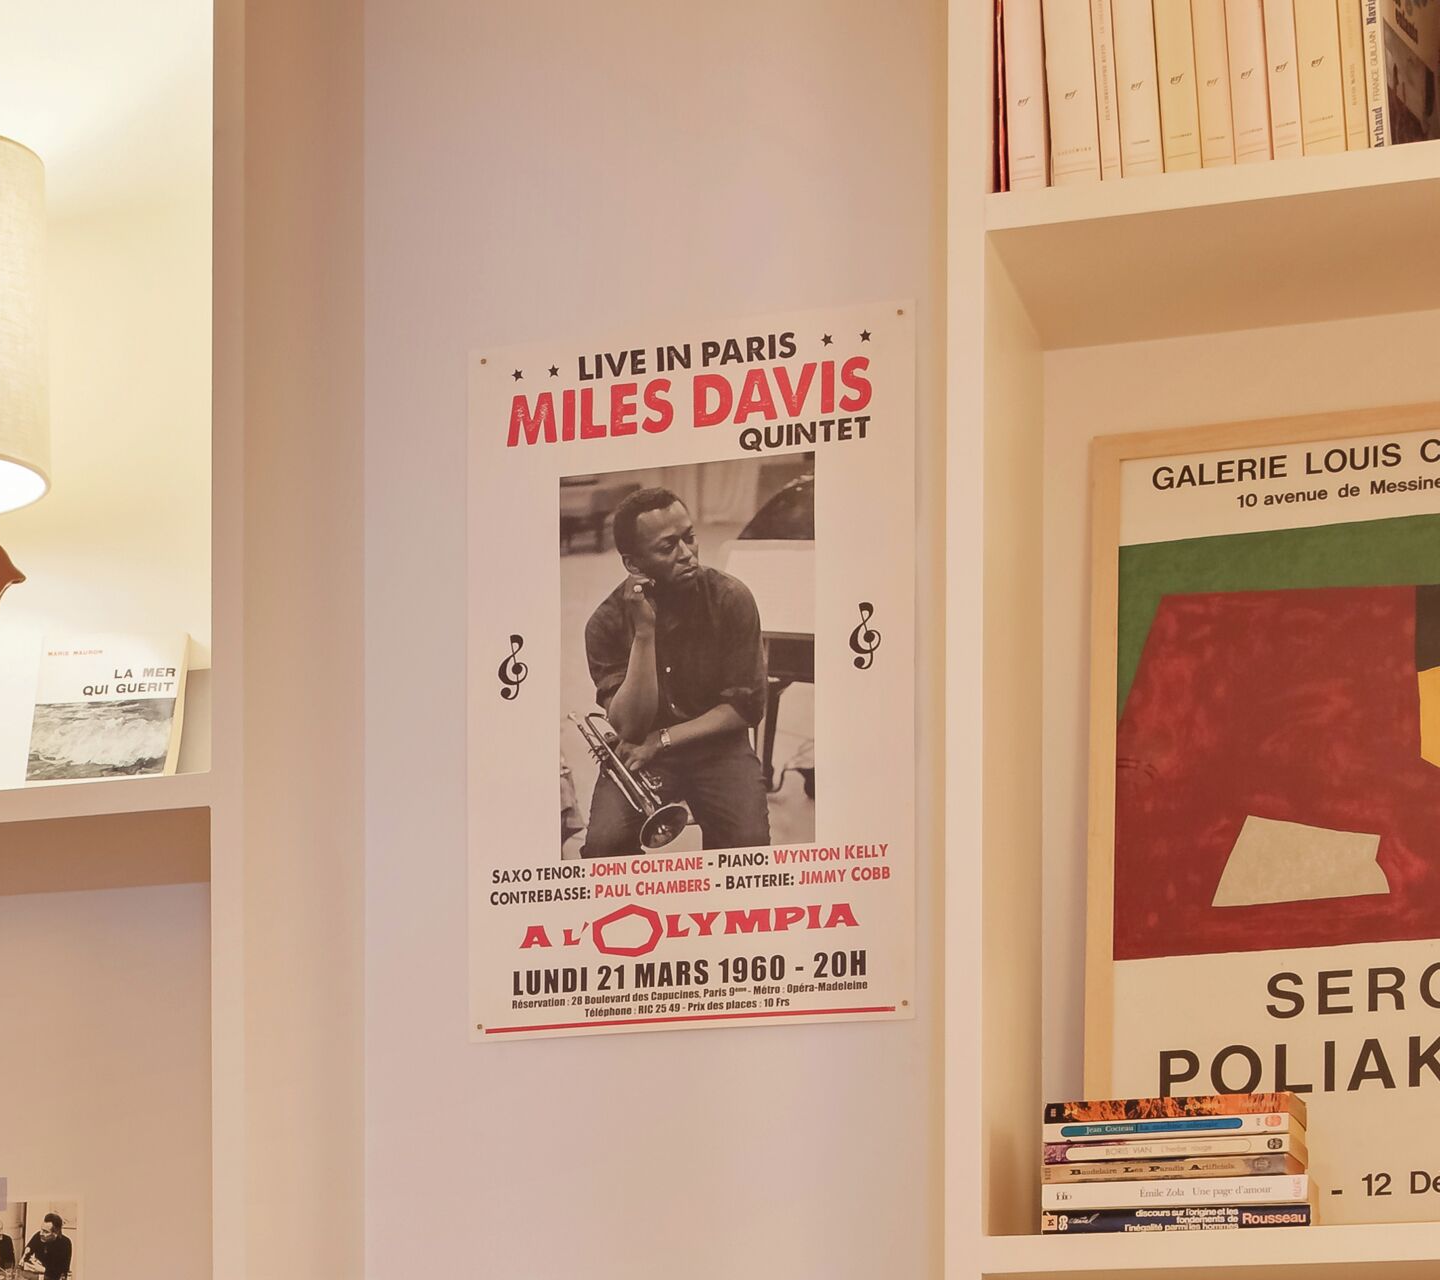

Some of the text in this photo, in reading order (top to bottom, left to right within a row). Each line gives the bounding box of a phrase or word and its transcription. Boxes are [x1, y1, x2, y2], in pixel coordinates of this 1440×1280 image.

[578, 331, 797, 381] LIVE IN PARIS
[506, 356, 872, 448] MILES DAVIS
[739, 415, 871, 451] QUINTET
[1152, 454, 1288, 490] GALERIE
[1306, 442, 1402, 476] LOUIS
[1237, 494, 1257, 508] 10
[1263, 488, 1328, 506] avenue
[1338, 482, 1360, 499] de
[114, 667, 176, 679] LA MER
[82, 682, 174, 696] QUI GUERIT
[492, 844, 888, 884] SAXO TENOR: JOHN COLTRANE PIANO: WYNTON KELLY
[490, 866, 890, 906] CONTREBASSE: PAUL CHAMBERS BATTERIE: JIMMY COBB
[519, 903, 860, 957] A L'OLYMPIA
[513, 967, 588, 996] LUNDI
[597, 964, 625, 991] 21
[635, 959, 709, 989] MARS
[718, 954, 785, 984] 1960
[813, 950, 867, 978] 20H
[512, 997, 566, 1010] Réservation
[572, 996, 583, 1006] 28
[585, 993, 631, 1005] Boulevard
[632, 991, 649, 1002] des
[703, 987, 727, 998] Paris
[753, 983, 781, 995] Métro
[787, 980, 868, 994] Opéra-Madeleine
[585, 997, 790, 1018] Téléphone RIC 25 49 Prix des places 10 Frs
[1086, 1126, 1102, 1135] Jean
[1166, 1188, 1185, 1197] Zola
[1192, 1187, 1211, 1195] Une
[1213, 1188, 1232, 1197] page
[1235, 1185, 1272, 1194] d'amour
[1361, 1172, 1392, 1196] 12
[1135, 1209, 1170, 1217] discours
[1185, 1207, 1216, 1216] l'origine
[1217, 1207, 1226, 1215] et
[1226, 1207, 1238, 1215] les
[1176, 1215, 1238, 1224] fondements de
[1242, 1212, 1306, 1225] Rousseau
[1165, 1224, 1188, 1232] parmi
[1202, 1222, 1239, 1230] hommes
